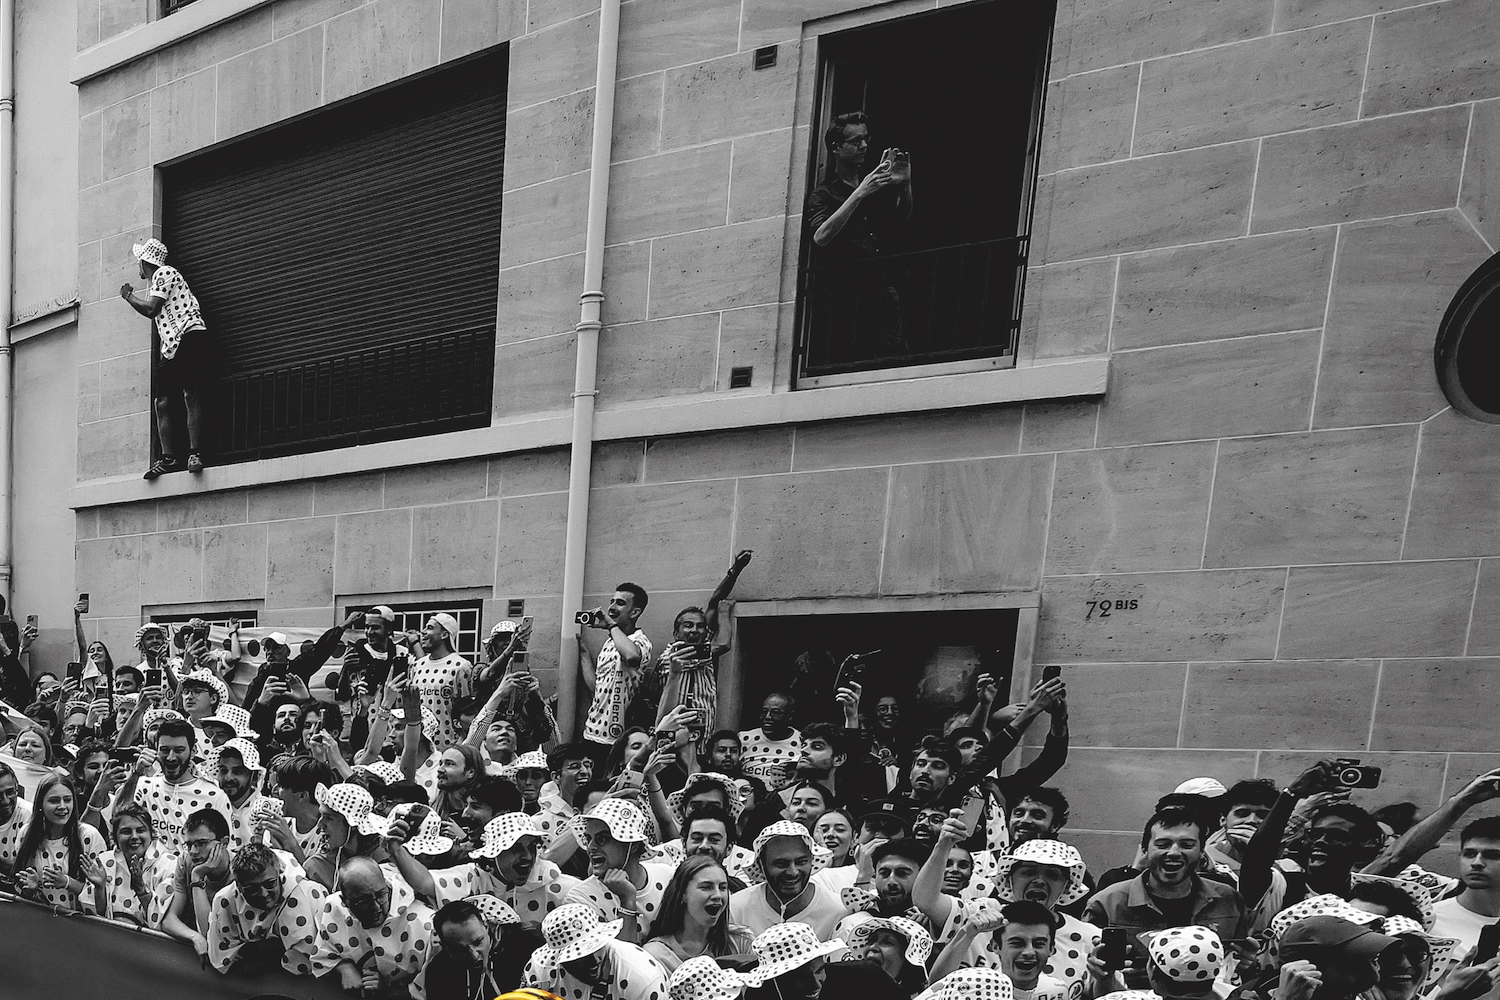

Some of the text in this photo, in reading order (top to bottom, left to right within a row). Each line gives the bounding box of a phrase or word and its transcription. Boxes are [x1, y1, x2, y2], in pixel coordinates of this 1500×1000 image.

[1086, 600, 1139, 620] 72 BIS
[612, 681, 622, 722] Leclerc
[151, 818, 186, 836] eclerc
